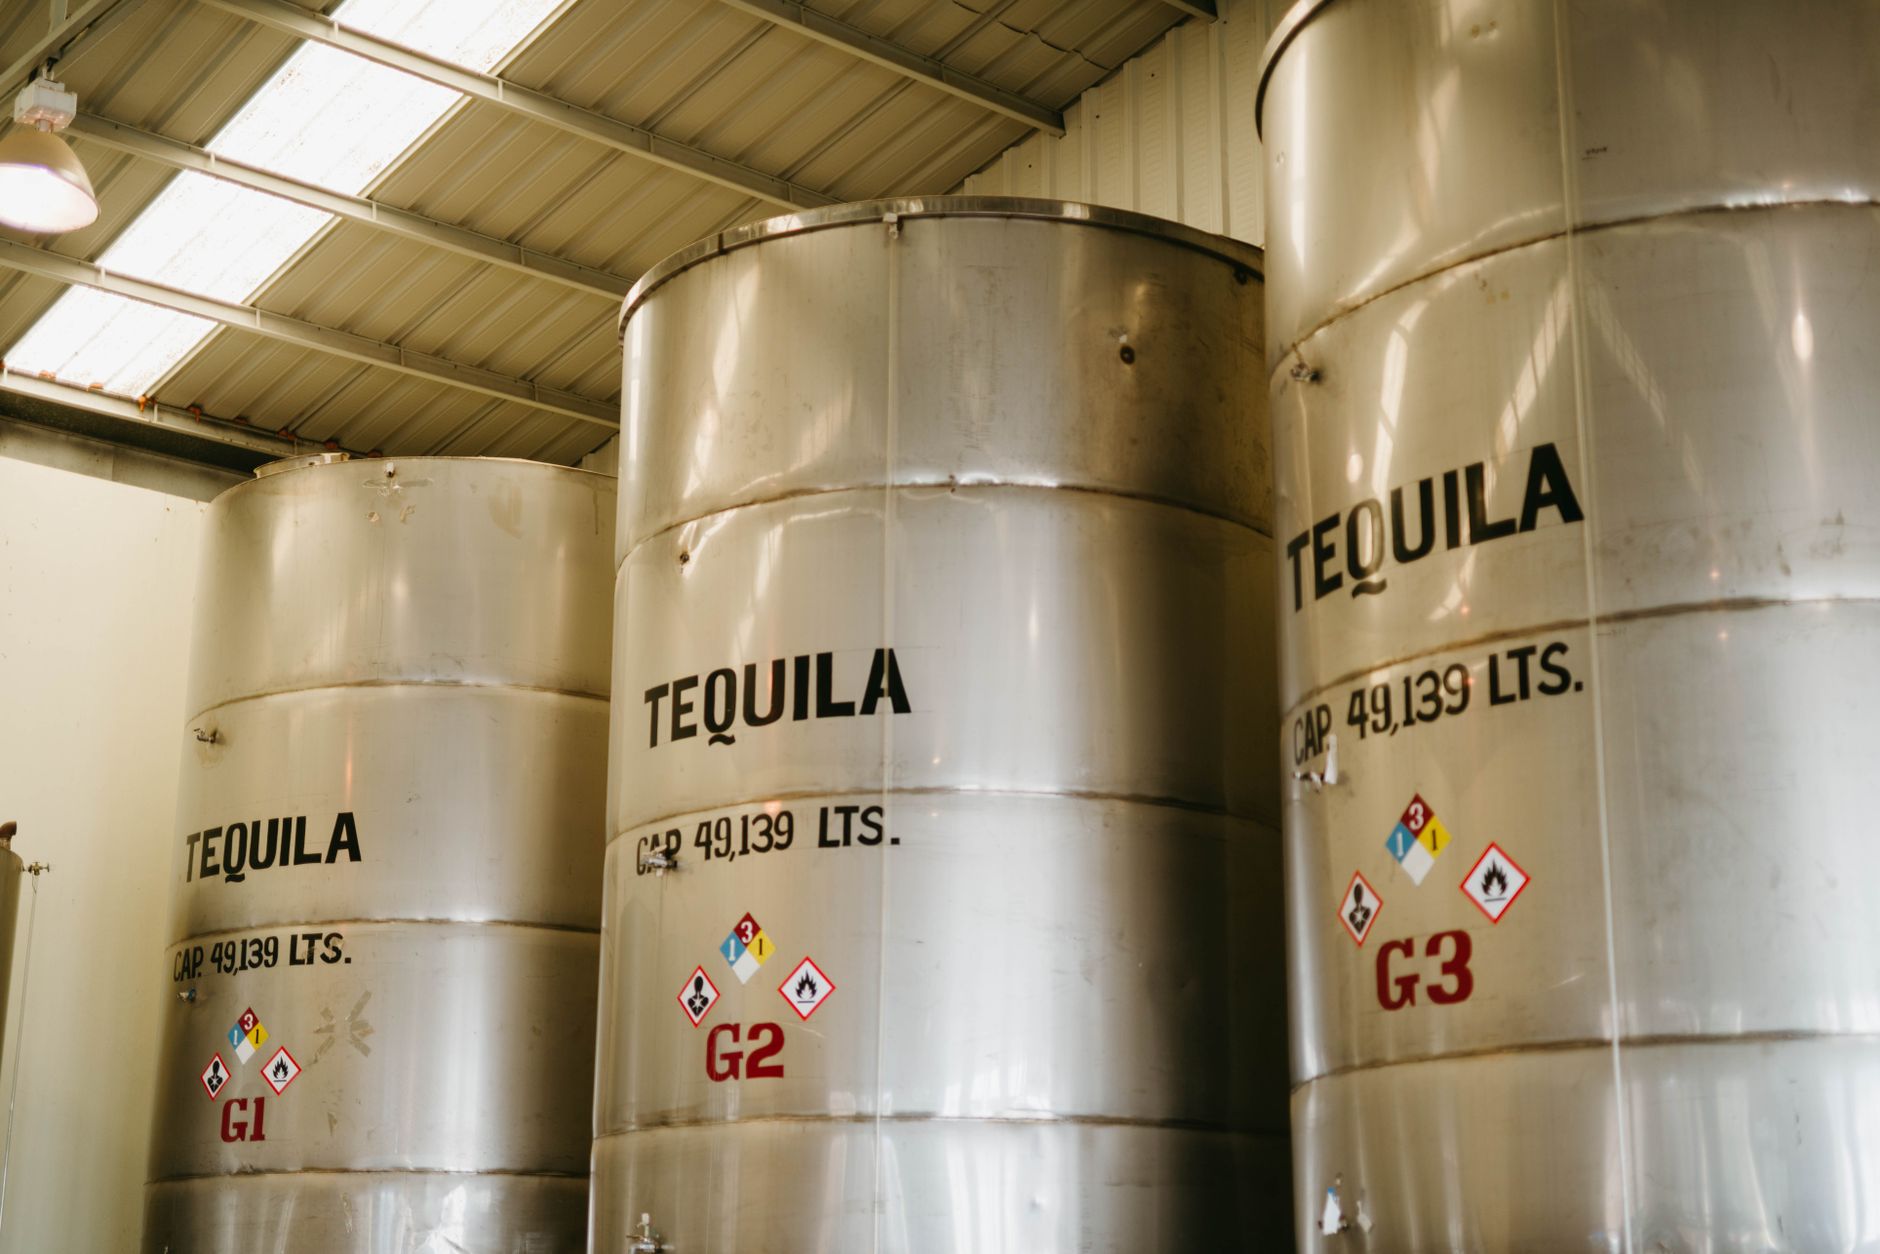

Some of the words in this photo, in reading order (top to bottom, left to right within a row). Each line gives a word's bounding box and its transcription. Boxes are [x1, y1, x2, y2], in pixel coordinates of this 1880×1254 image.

[1286, 442, 1585, 613] TEQUILA
[643, 648, 912, 749] TEQUILA
[1346, 663, 1471, 740] 49,139
[1488, 642, 1584, 706] LTS.
[693, 810, 794, 862] 49,139
[818, 805, 901, 848] LTS.
[1409, 803, 1424, 830] 3
[1431, 829, 1439, 851] 1
[186, 811, 362, 883] TEQUILA
[1396, 832, 1404, 857] 1
[728, 937, 737, 961] 1
[741, 920, 753, 943] 3
[758, 938, 764, 956] 1
[173, 945, 204, 982] CAP.
[210, 935, 279, 976] 49,139
[288, 932, 352, 967] LTS.
[1375, 929, 1474, 1011] G3
[244, 1013, 253, 1030] 3
[705, 1022, 785, 1082] G2
[220, 1096, 266, 1143] G1
